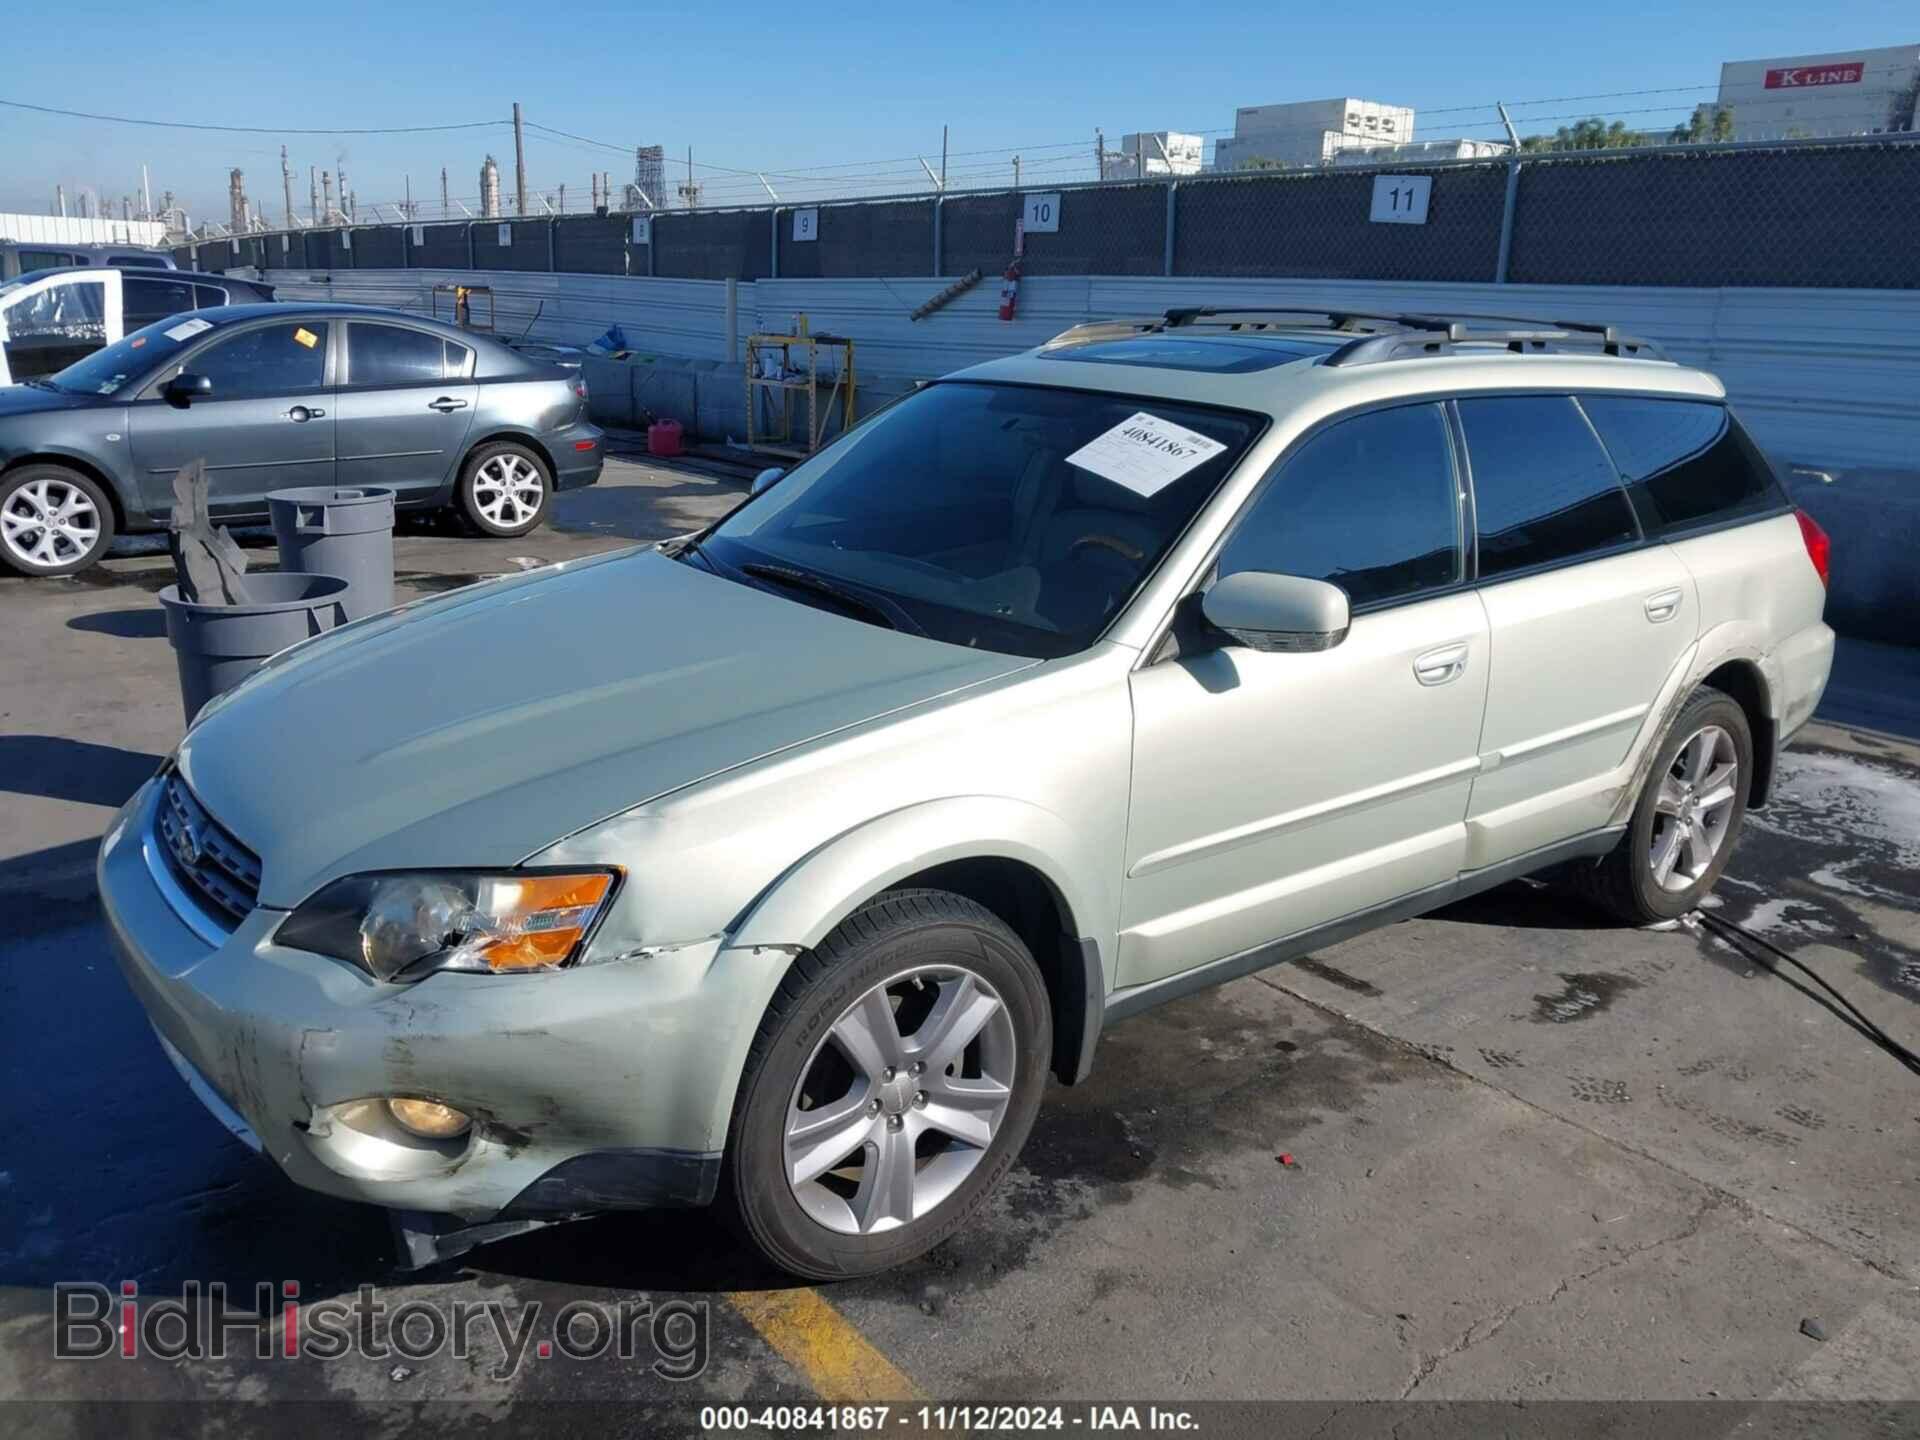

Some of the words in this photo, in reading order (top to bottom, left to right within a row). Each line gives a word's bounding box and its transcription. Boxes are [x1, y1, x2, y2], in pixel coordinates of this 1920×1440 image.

[1780, 70, 1800, 86] K
[1805, 69, 1857, 84] LINE
[1390, 187, 1415, 211] 11
[1032, 203, 1050, 223] 10
[801, 216, 809, 233] 9
[1122, 427, 1198, 459] 40841867
